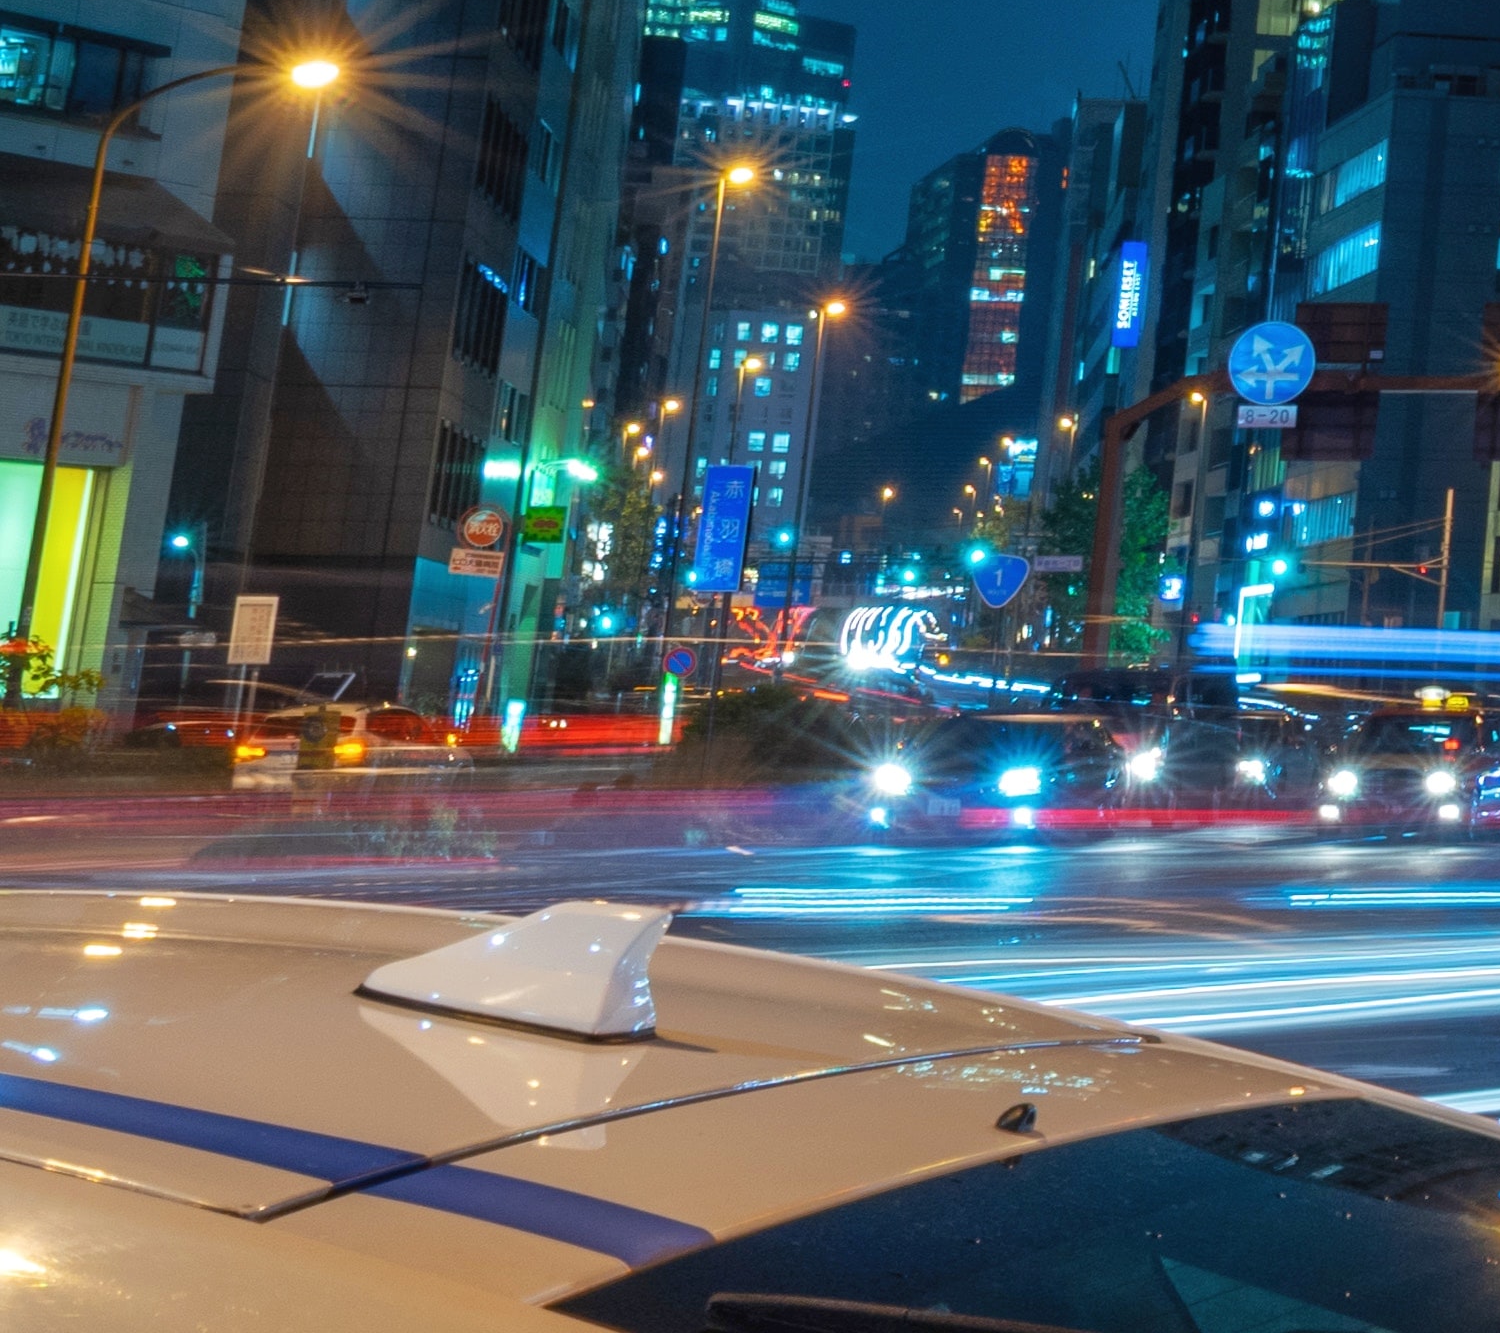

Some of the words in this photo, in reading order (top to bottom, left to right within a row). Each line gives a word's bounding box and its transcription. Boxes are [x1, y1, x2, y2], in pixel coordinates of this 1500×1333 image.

[1245, 409, 1290, 424] 8-20
[714, 480, 745, 578] 赤羽橋
[993, 569, 1003, 587] 1
